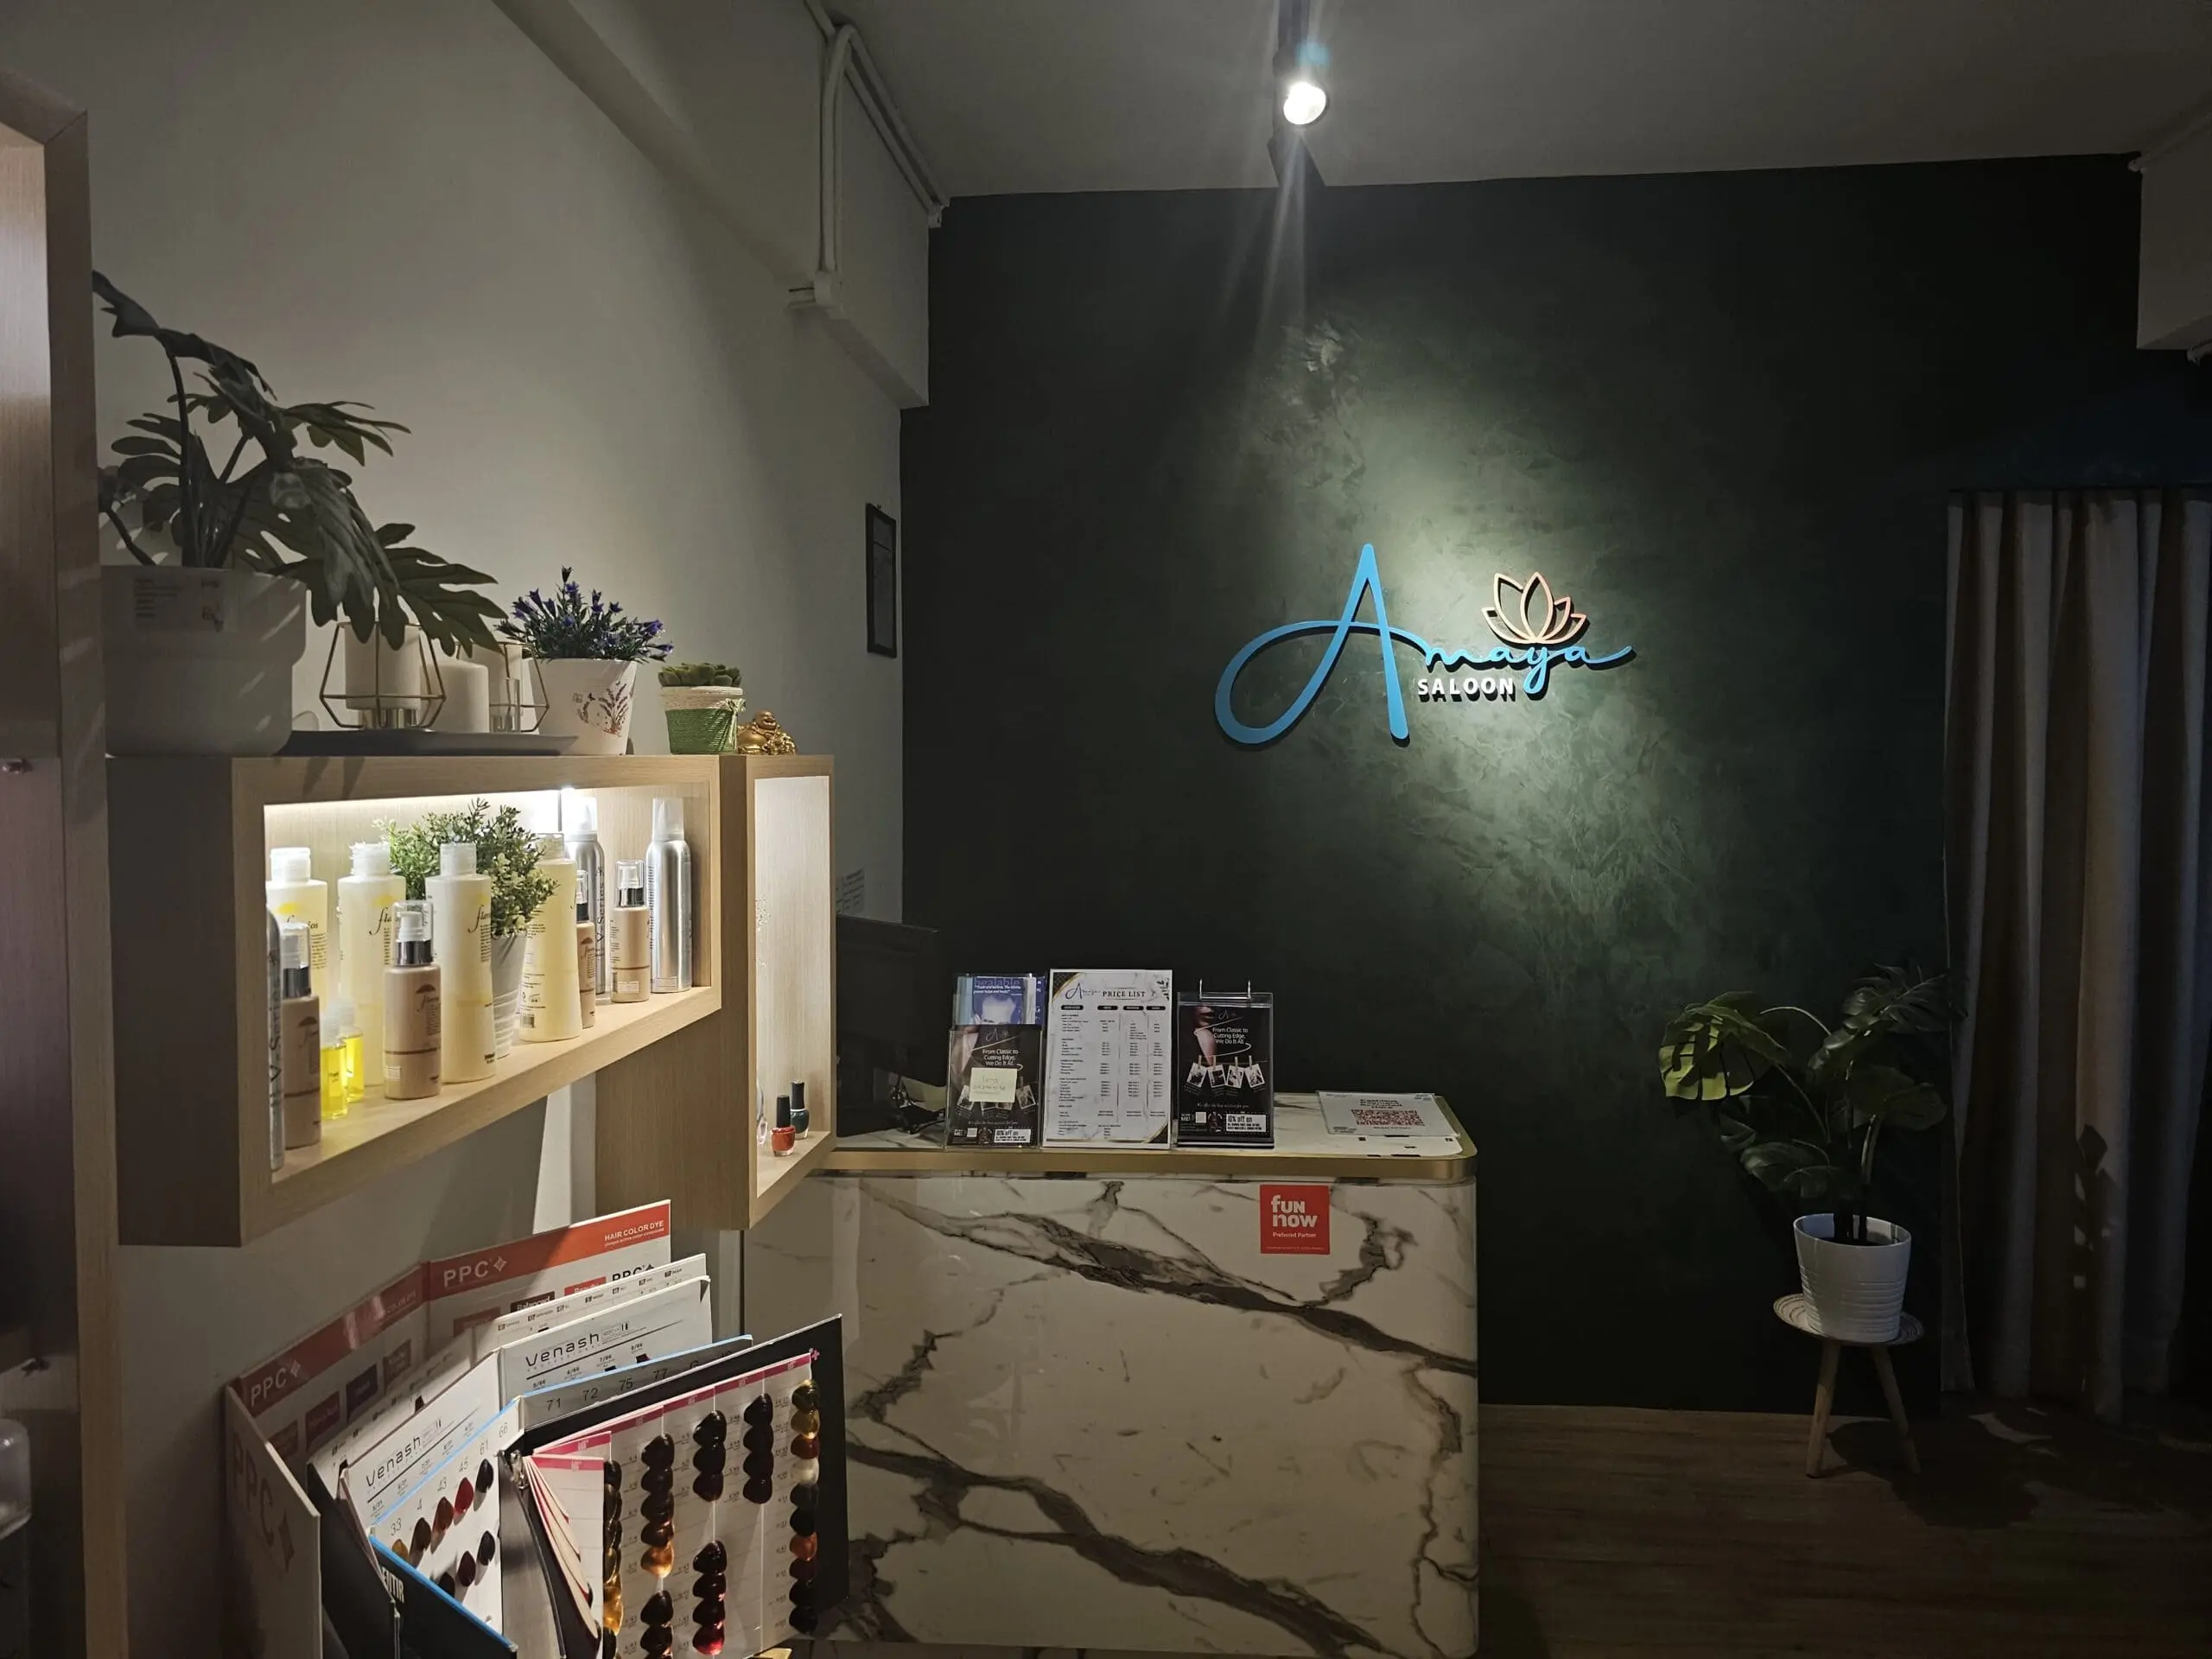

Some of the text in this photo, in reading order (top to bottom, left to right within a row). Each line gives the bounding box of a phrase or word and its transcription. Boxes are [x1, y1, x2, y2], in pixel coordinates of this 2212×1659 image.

[1215, 543, 1633, 744] Amaya
[1417, 677, 1514, 697] SALOON
[604, 1231, 622, 1242] HAIR
[623, 1224, 649, 1236] COLOR
[650, 1219, 664, 1229] DYE
[443, 1260, 489, 1287] PPC
[525, 1333, 599, 1366] Venash
[251, 1367, 288, 1408] PPC
[546, 1397, 562, 1411] 71
[582, 1388, 598, 1402] 72
[619, 1377, 633, 1392] 75
[652, 1368, 668, 1382] 77
[365, 1436, 421, 1487] Venash
[391, 1422, 508, 1536] 33 4 43 45 61 66
